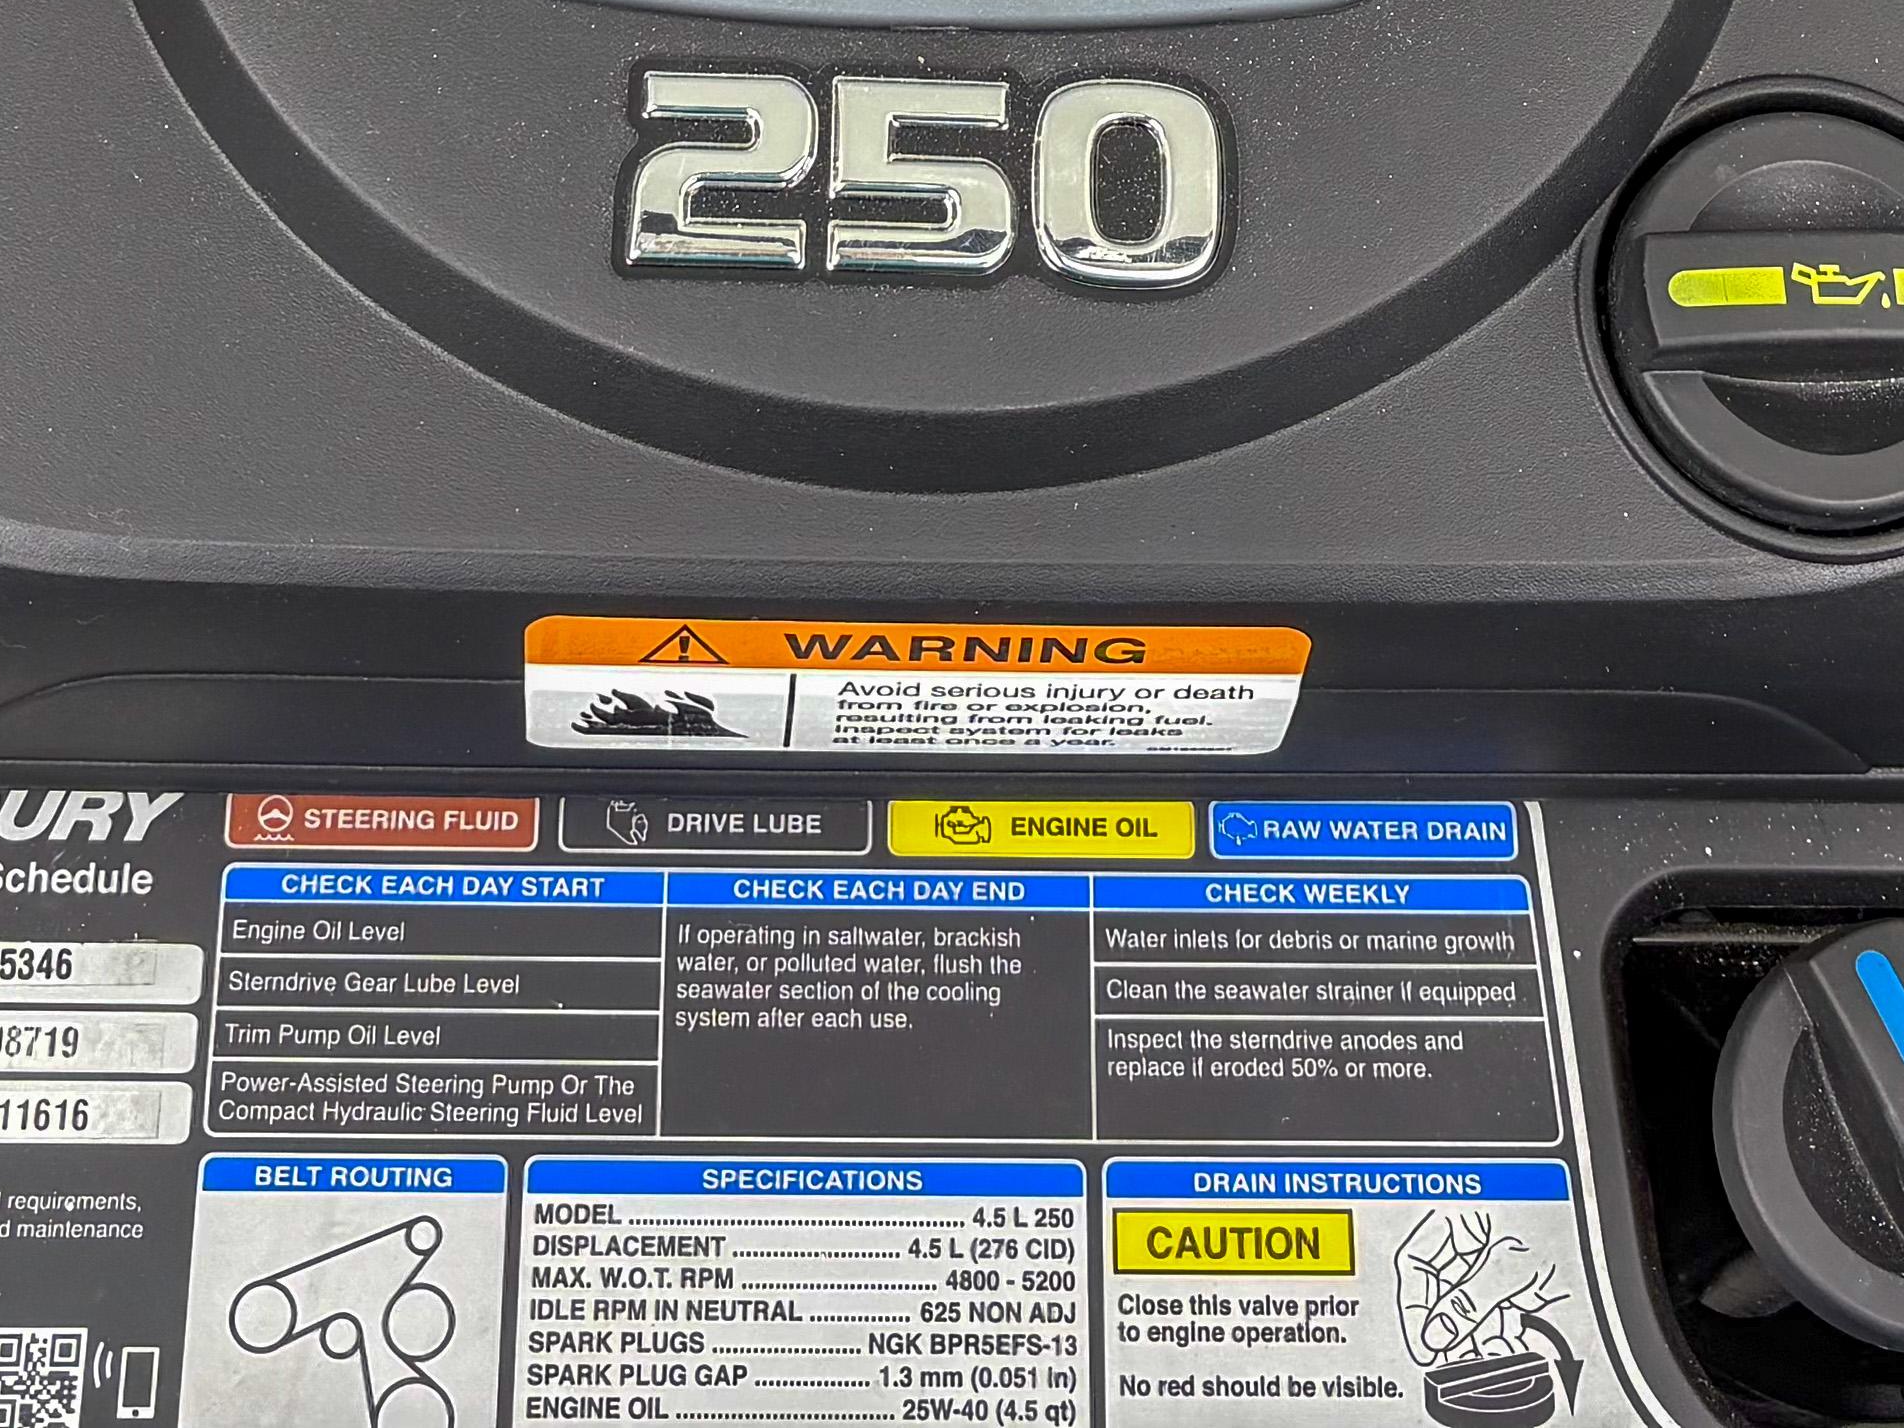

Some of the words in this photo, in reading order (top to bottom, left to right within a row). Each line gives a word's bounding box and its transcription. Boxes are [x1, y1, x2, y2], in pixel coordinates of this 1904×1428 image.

[625, 71, 1225, 291] 250
[783, 633, 1146, 665] WARNING
[837, 681, 923, 703] Avoid
[930, 683, 1036, 699] serious
[1046, 683, 1126, 702] injury
[1134, 688, 1166, 700] or
[1173, 684, 1254, 700] death
[837, 699, 903, 711] from
[914, 700, 958, 711] fire
[966, 703, 998, 712] or
[1005, 701, 1151, 715] explosion,
[835, 713, 958, 726] resulting
[968, 713, 1033, 725] from
[1043, 714, 1145, 727] leaking
[1155, 715, 1213, 726] fuel.
[304, 808, 435, 830] STEERING
[443, 810, 519, 831] FLUID
[667, 813, 745, 833] DRIVE
[753, 813, 822, 834] LUBE
[1011, 816, 1108, 837] ENGINE
[1115, 817, 1158, 838] OIL
[1263, 820, 1321, 839] RAW
[1329, 820, 1418, 840] WATER
[1427, 821, 1506, 841] DRAIN
[281, 874, 372, 895] CHECK
[381, 875, 454, 895] EACH
[462, 876, 514, 896] DAY
[521, 876, 605, 897] START
[733, 879, 824, 899] CHECK
[833, 879, 905, 900] EACH
[913, 880, 964, 901] DAY
[972, 881, 1025, 901] END
[1205, 883, 1296, 904] CHECK
[1303, 884, 1410, 905] WEEKLY
[232, 919, 306, 945] Engine
[312, 920, 342, 940] Oil
[348, 921, 405, 941] Level
[678, 923, 691, 944] If
[697, 926, 795, 949] operating
[803, 929, 821, 945] in
[828, 926, 926, 948] saltwater,
[934, 927, 1021, 948] brackish
[1105, 928, 1167, 949] Water
[1174, 929, 1229, 949] inlets
[1235, 928, 1263, 949] for
[1269, 929, 1333, 950] debris
[1339, 934, 1360, 950] or
[1366, 934, 1438, 951] marine
[1444, 930, 1515, 955] growth
[228, 970, 337, 993] Sterndrive
[344, 971, 398, 993] Gear
[404, 972, 456, 993] Lube
[463, 973, 520, 994] Level
[675, 1007, 750, 1033] system
[757, 1007, 805, 1028] after
[811, 1008, 862, 1029] each
[870, 1012, 913, 1029] use.
[221, 1071, 388, 1093] Power-Assisted
[395, 1072, 484, 1099] Steering
[492, 1073, 554, 1100] Pump
[561, 1074, 588, 1095] Or
[594, 1074, 635, 1096] The
[255, 1165, 323, 1187] BELT
[330, 1165, 452, 1188] ROUTING
[702, 1168, 923, 1191] SPECIFICATIONS
[1194, 1172, 1276, 1193] DRAIN
[1285, 1173, 1482, 1195] INSTRUCTIONS
[7, 1193, 141, 1215] requirements,
[534, 1203, 623, 1225] MODEL
[972, 1206, 1006, 1228] 4.5
[1013, 1206, 1029, 1228] L
[1034, 1207, 1074, 1229] 250
[16, 1220, 144, 1239] maintenance
[1146, 1225, 1321, 1260] CAUTION
[528, 1330, 613, 1354] SPARK
[620, 1331, 705, 1354] PLUGS
[868, 1332, 923, 1355] NGK
[930, 1333, 1078, 1357] BPR5EFS-13
[1119, 1374, 1152, 1397] No
[1157, 1374, 1195, 1397] red
[1202, 1374, 1281, 1398] should
[1287, 1375, 1317, 1398] be
[1321, 1375, 1404, 1399] visible.
[525, 1396, 621, 1420] ENGINE
[628, 1396, 670, 1420] OIL
[902, 1398, 989, 1422] 25W-40
[995, 1398, 1038, 1427] (4.5
[1044, 1398, 1076, 1428] qt)
